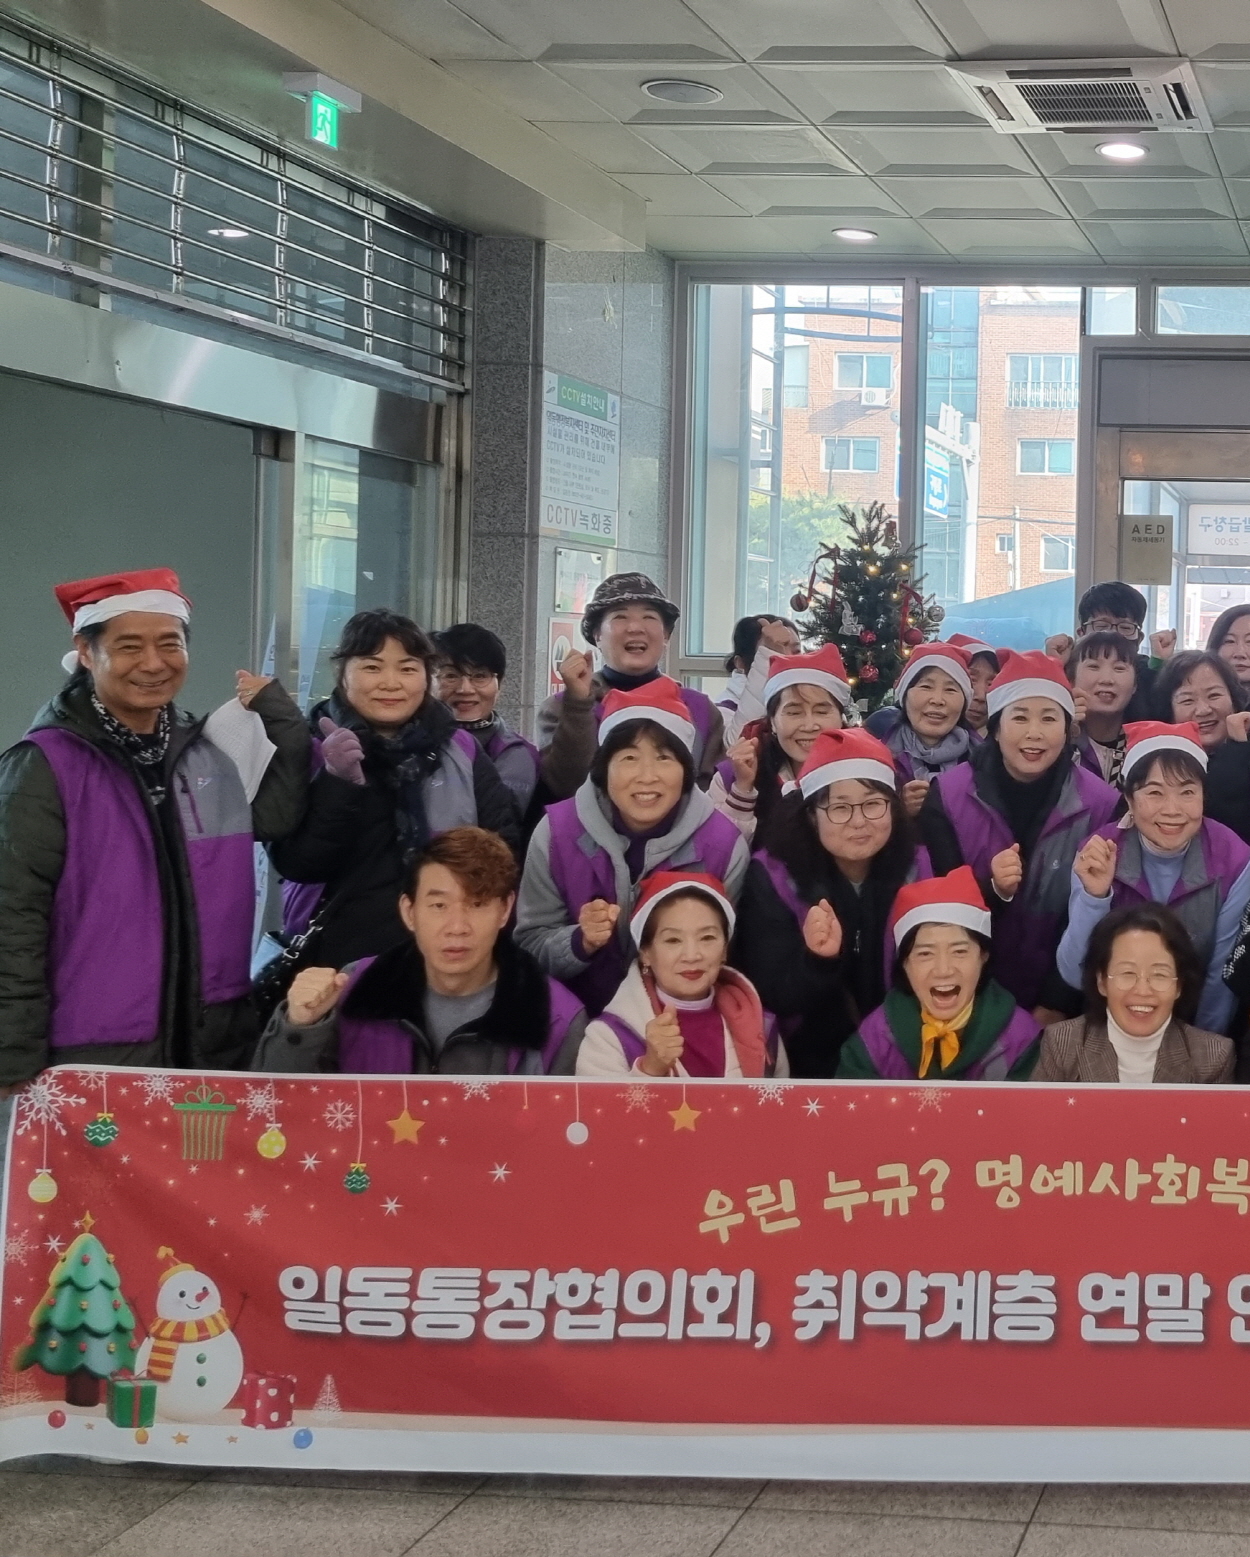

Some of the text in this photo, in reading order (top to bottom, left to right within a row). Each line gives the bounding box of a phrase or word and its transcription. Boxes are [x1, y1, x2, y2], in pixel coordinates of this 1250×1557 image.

[561, 386, 605, 413] CCTV설치안내
[546, 503, 613, 536] CCTV녹화중
[698, 1178, 801, 1243] 우린
[822, 1157, 951, 1222] 누규?
[278, 1264, 771, 1350] 일동통장협의회,
[793, 1268, 1058, 1343] 취약계층
[1077, 1270, 1211, 1344] 연말
